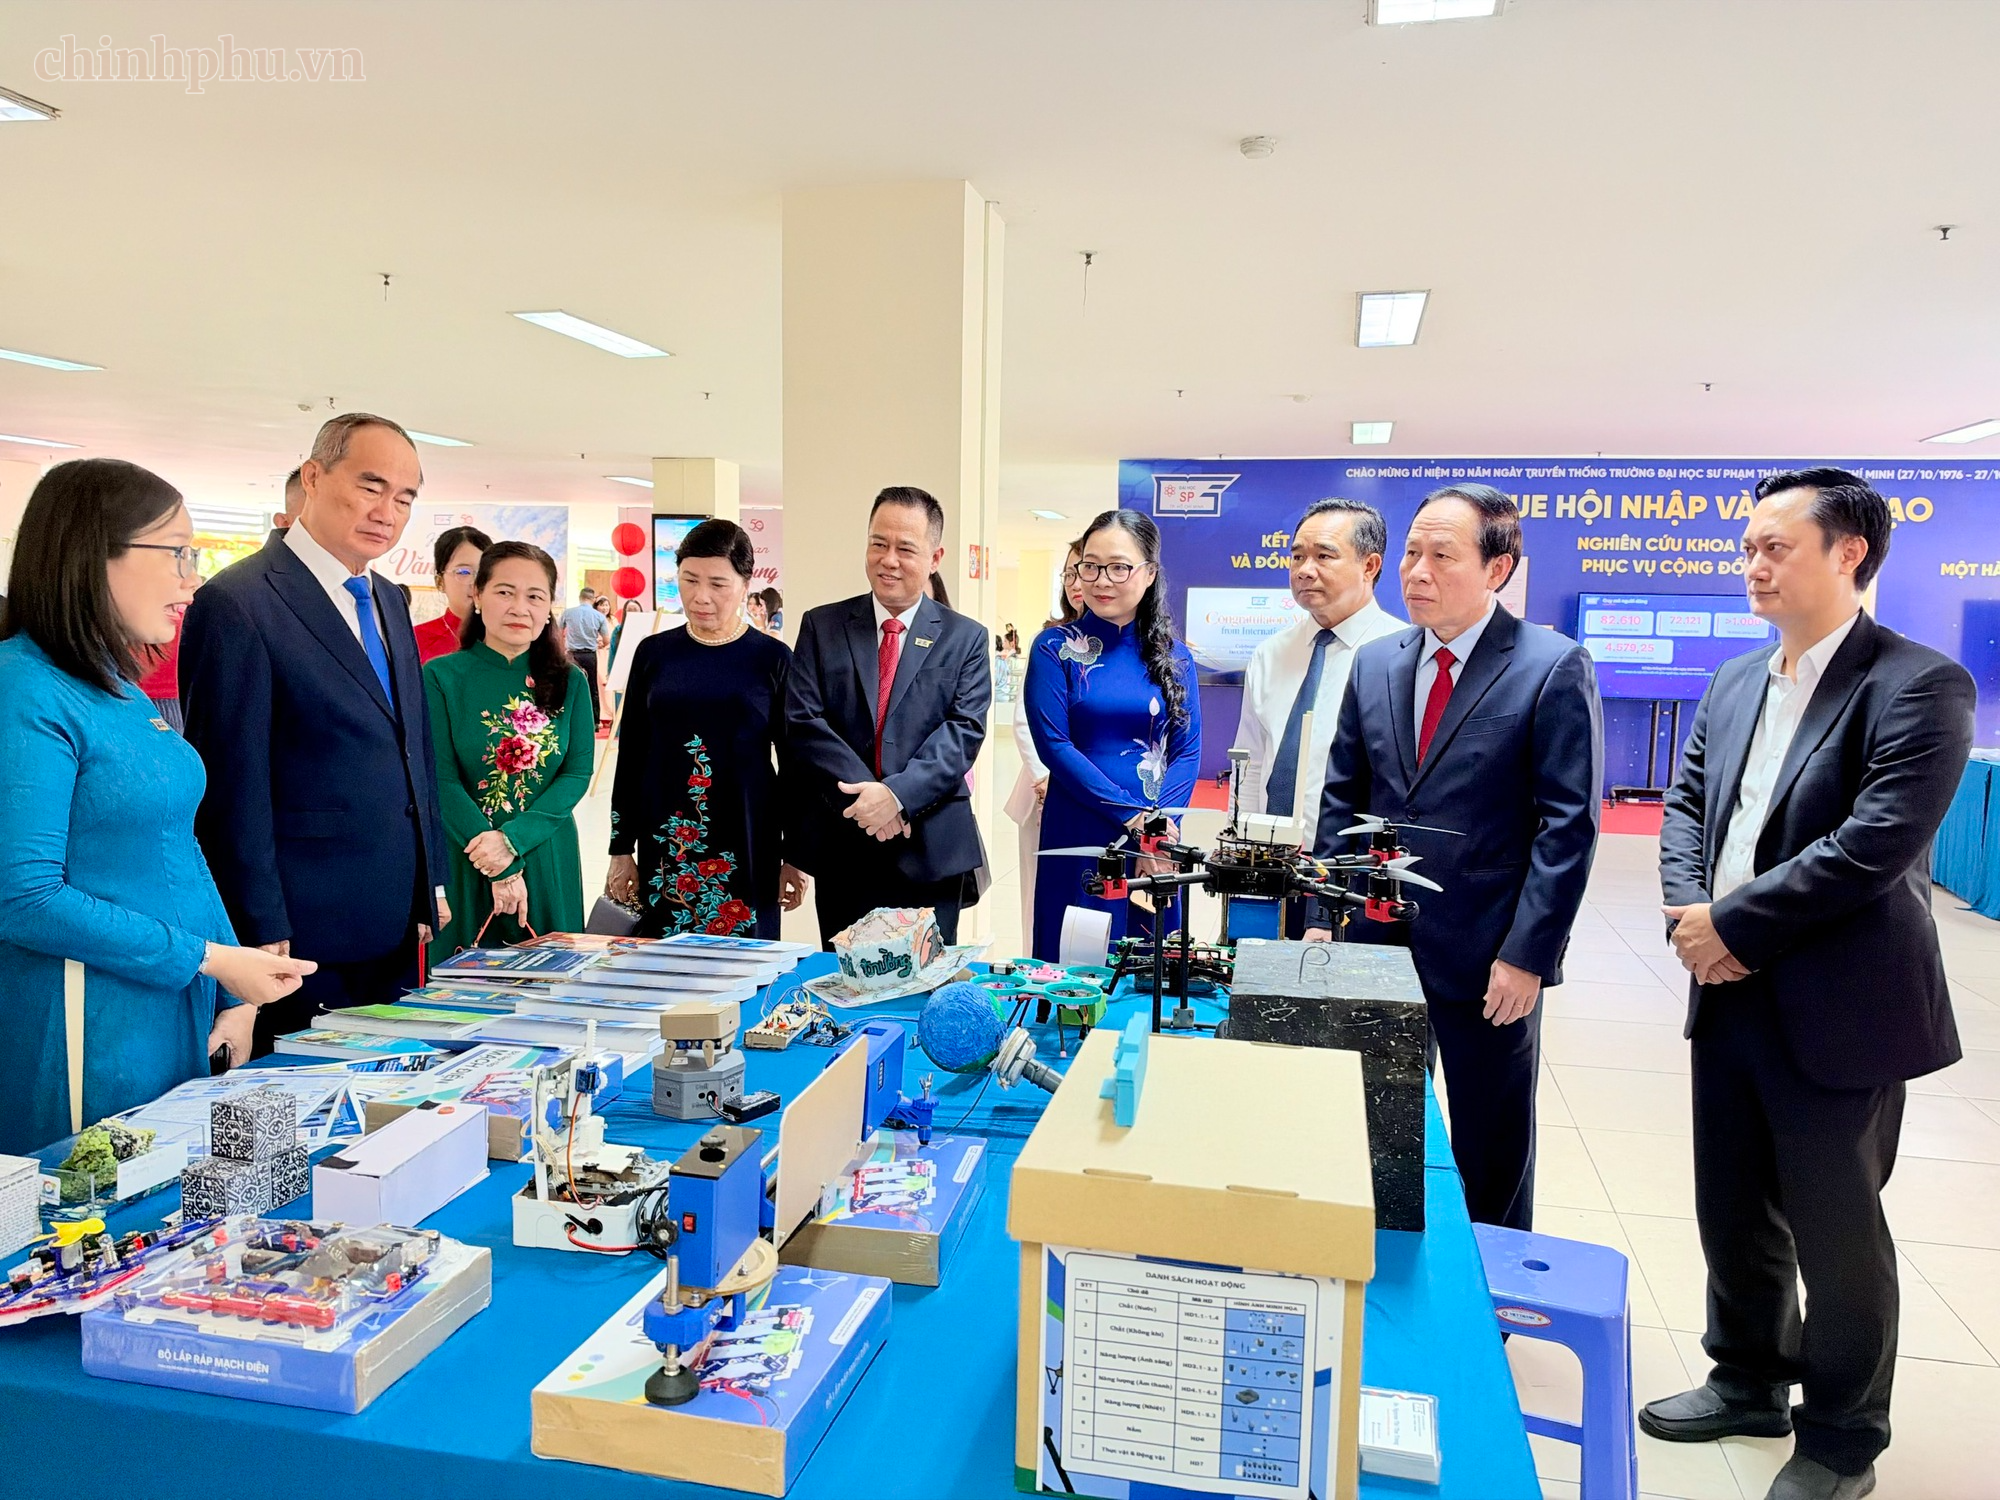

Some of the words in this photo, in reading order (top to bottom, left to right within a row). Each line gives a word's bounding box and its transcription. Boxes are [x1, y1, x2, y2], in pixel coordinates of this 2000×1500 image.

[1345, 466, 1376, 478] CHÀO
[1378, 466, 1410, 478] MỪNG
[1424, 466, 1450, 480] NIỆM
[1452, 468, 1465, 478] 50
[1467, 466, 1490, 478] NĂM
[1493, 465, 1522, 478] NGÀY
[1568, 465, 1608, 478] THỐNG
[1609, 466, 1656, 478] TRƯỜNG
[1658, 468, 1677, 480] ĐẠI
[1679, 468, 1704, 480] HỌC
[1706, 467, 1722, 478] SƯ
[1724, 468, 1755, 481] PHẠM
[1866, 469, 1895, 480] MINH
[1898, 468, 1964, 480] (27/10/1976
[1179, 492, 1195, 503] SP
[1511, 494, 1548, 518] UE
[1555, 488, 1612, 525] HỘI
[1620, 489, 1707, 526] NHẬP
[1716, 490, 1756, 520] VÀ
[1261, 530, 1291, 548] KẾT
[1577, 534, 1642, 551] NGHIÊN
[1645, 534, 1682, 551] CỨU
[1686, 539, 1736, 552] KHOA
[1231, 552, 1251, 568] VÀ
[1255, 550, 1291, 569] ĐỒN
[1582, 559, 1628, 577] PHỤC
[1632, 560, 1656, 578] VỤ
[1659, 557, 1714, 578] CỘNG
[1717, 556, 1745, 576] ĐỒ
[752, 567, 779, 584] ung
[1940, 560, 1978, 580] MỘT
[1601, 616, 1641, 625] 82.610
[1670, 616, 1702, 625] 72.121
[1146, 1272, 1170, 1280] DANH
[1171, 1274, 1194, 1284] SÁCH
[1195, 1279, 1219, 1288] HOẠT
[1220, 1280, 1246, 1290] ĐỘNG
[158, 1348, 172, 1362] BỘ
[214, 1358, 244, 1370] MẠCH
[246, 1361, 269, 1374] ĐIỆN
